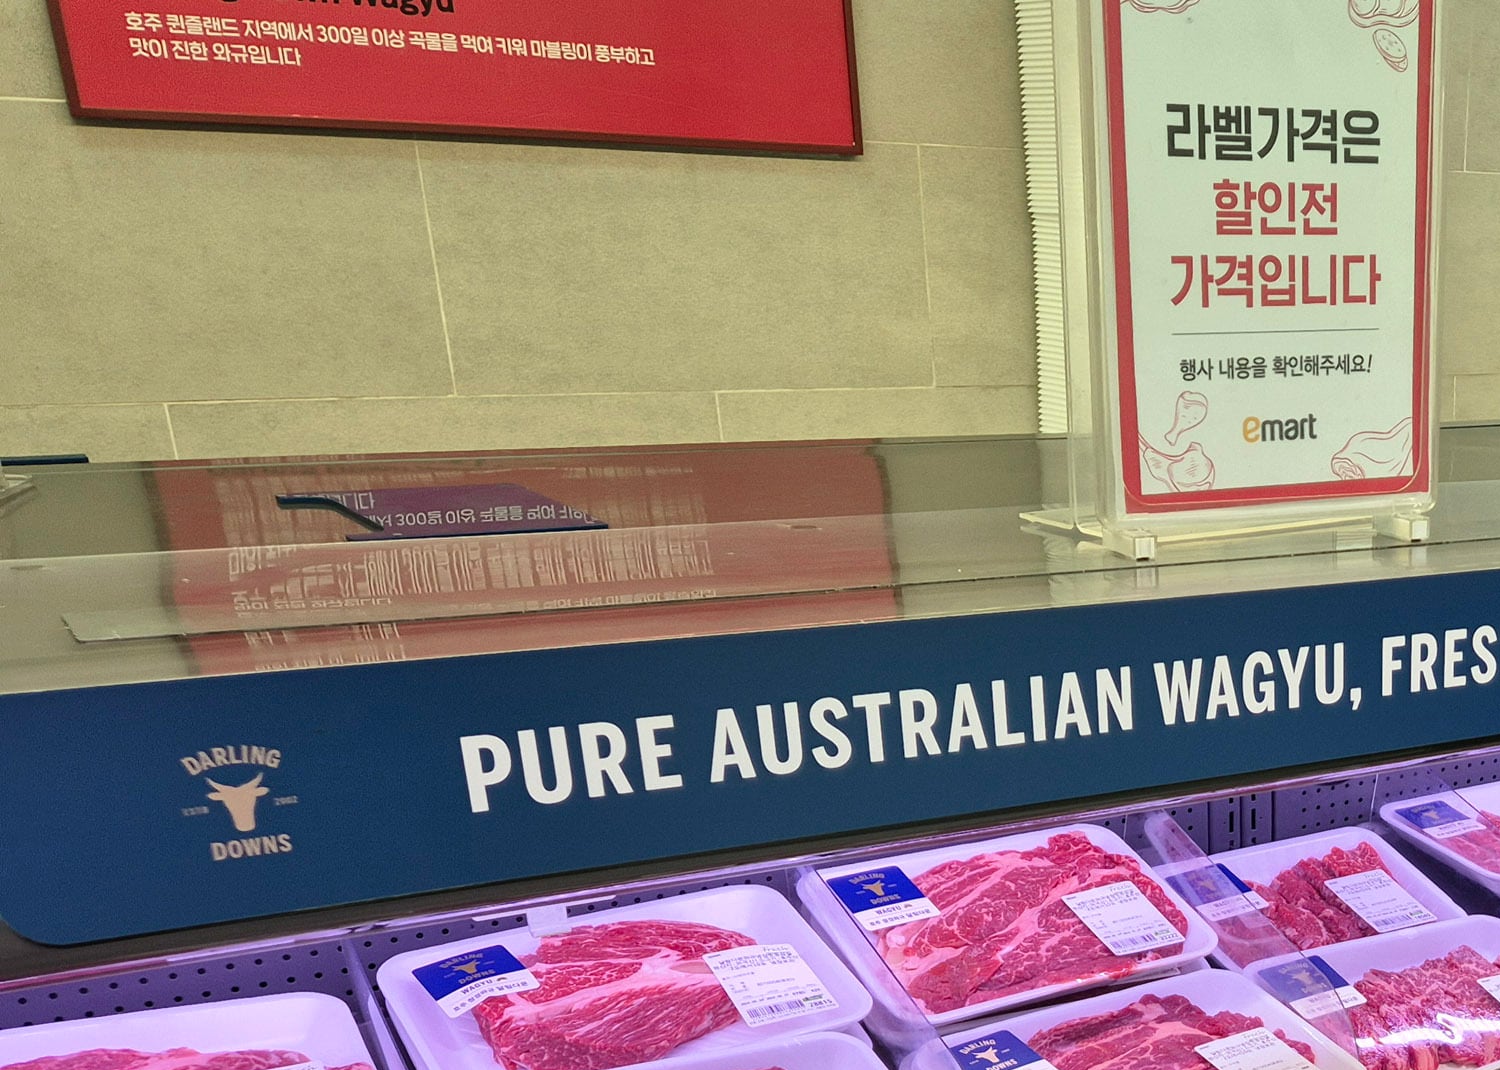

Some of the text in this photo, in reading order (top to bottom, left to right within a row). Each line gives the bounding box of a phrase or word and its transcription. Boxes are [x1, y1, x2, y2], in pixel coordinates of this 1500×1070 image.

[124, 11, 656, 67] 호주 퀸즐랜드 지역에서 300일 이상 곡물을 먹여 키워 마블링이 풍부하고
[128, 37, 302, 67] 맛이 진한 와규입니다
[1166, 103, 1381, 164] 라벨가격은
[1212, 178, 1338, 237] 할인전
[1169, 254, 1381, 308] 가격입니다
[1179, 353, 1373, 382] 행사 내용을 확인해주세요!
[1242, 413, 1318, 443] emart
[459, 714, 684, 813] PURE
[710, 665, 1133, 783] AUSTRALIAN
[1153, 642, 1362, 726] WAGYU,
[181, 744, 282, 776] DARLING
[210, 833, 293, 861] DOWNS
